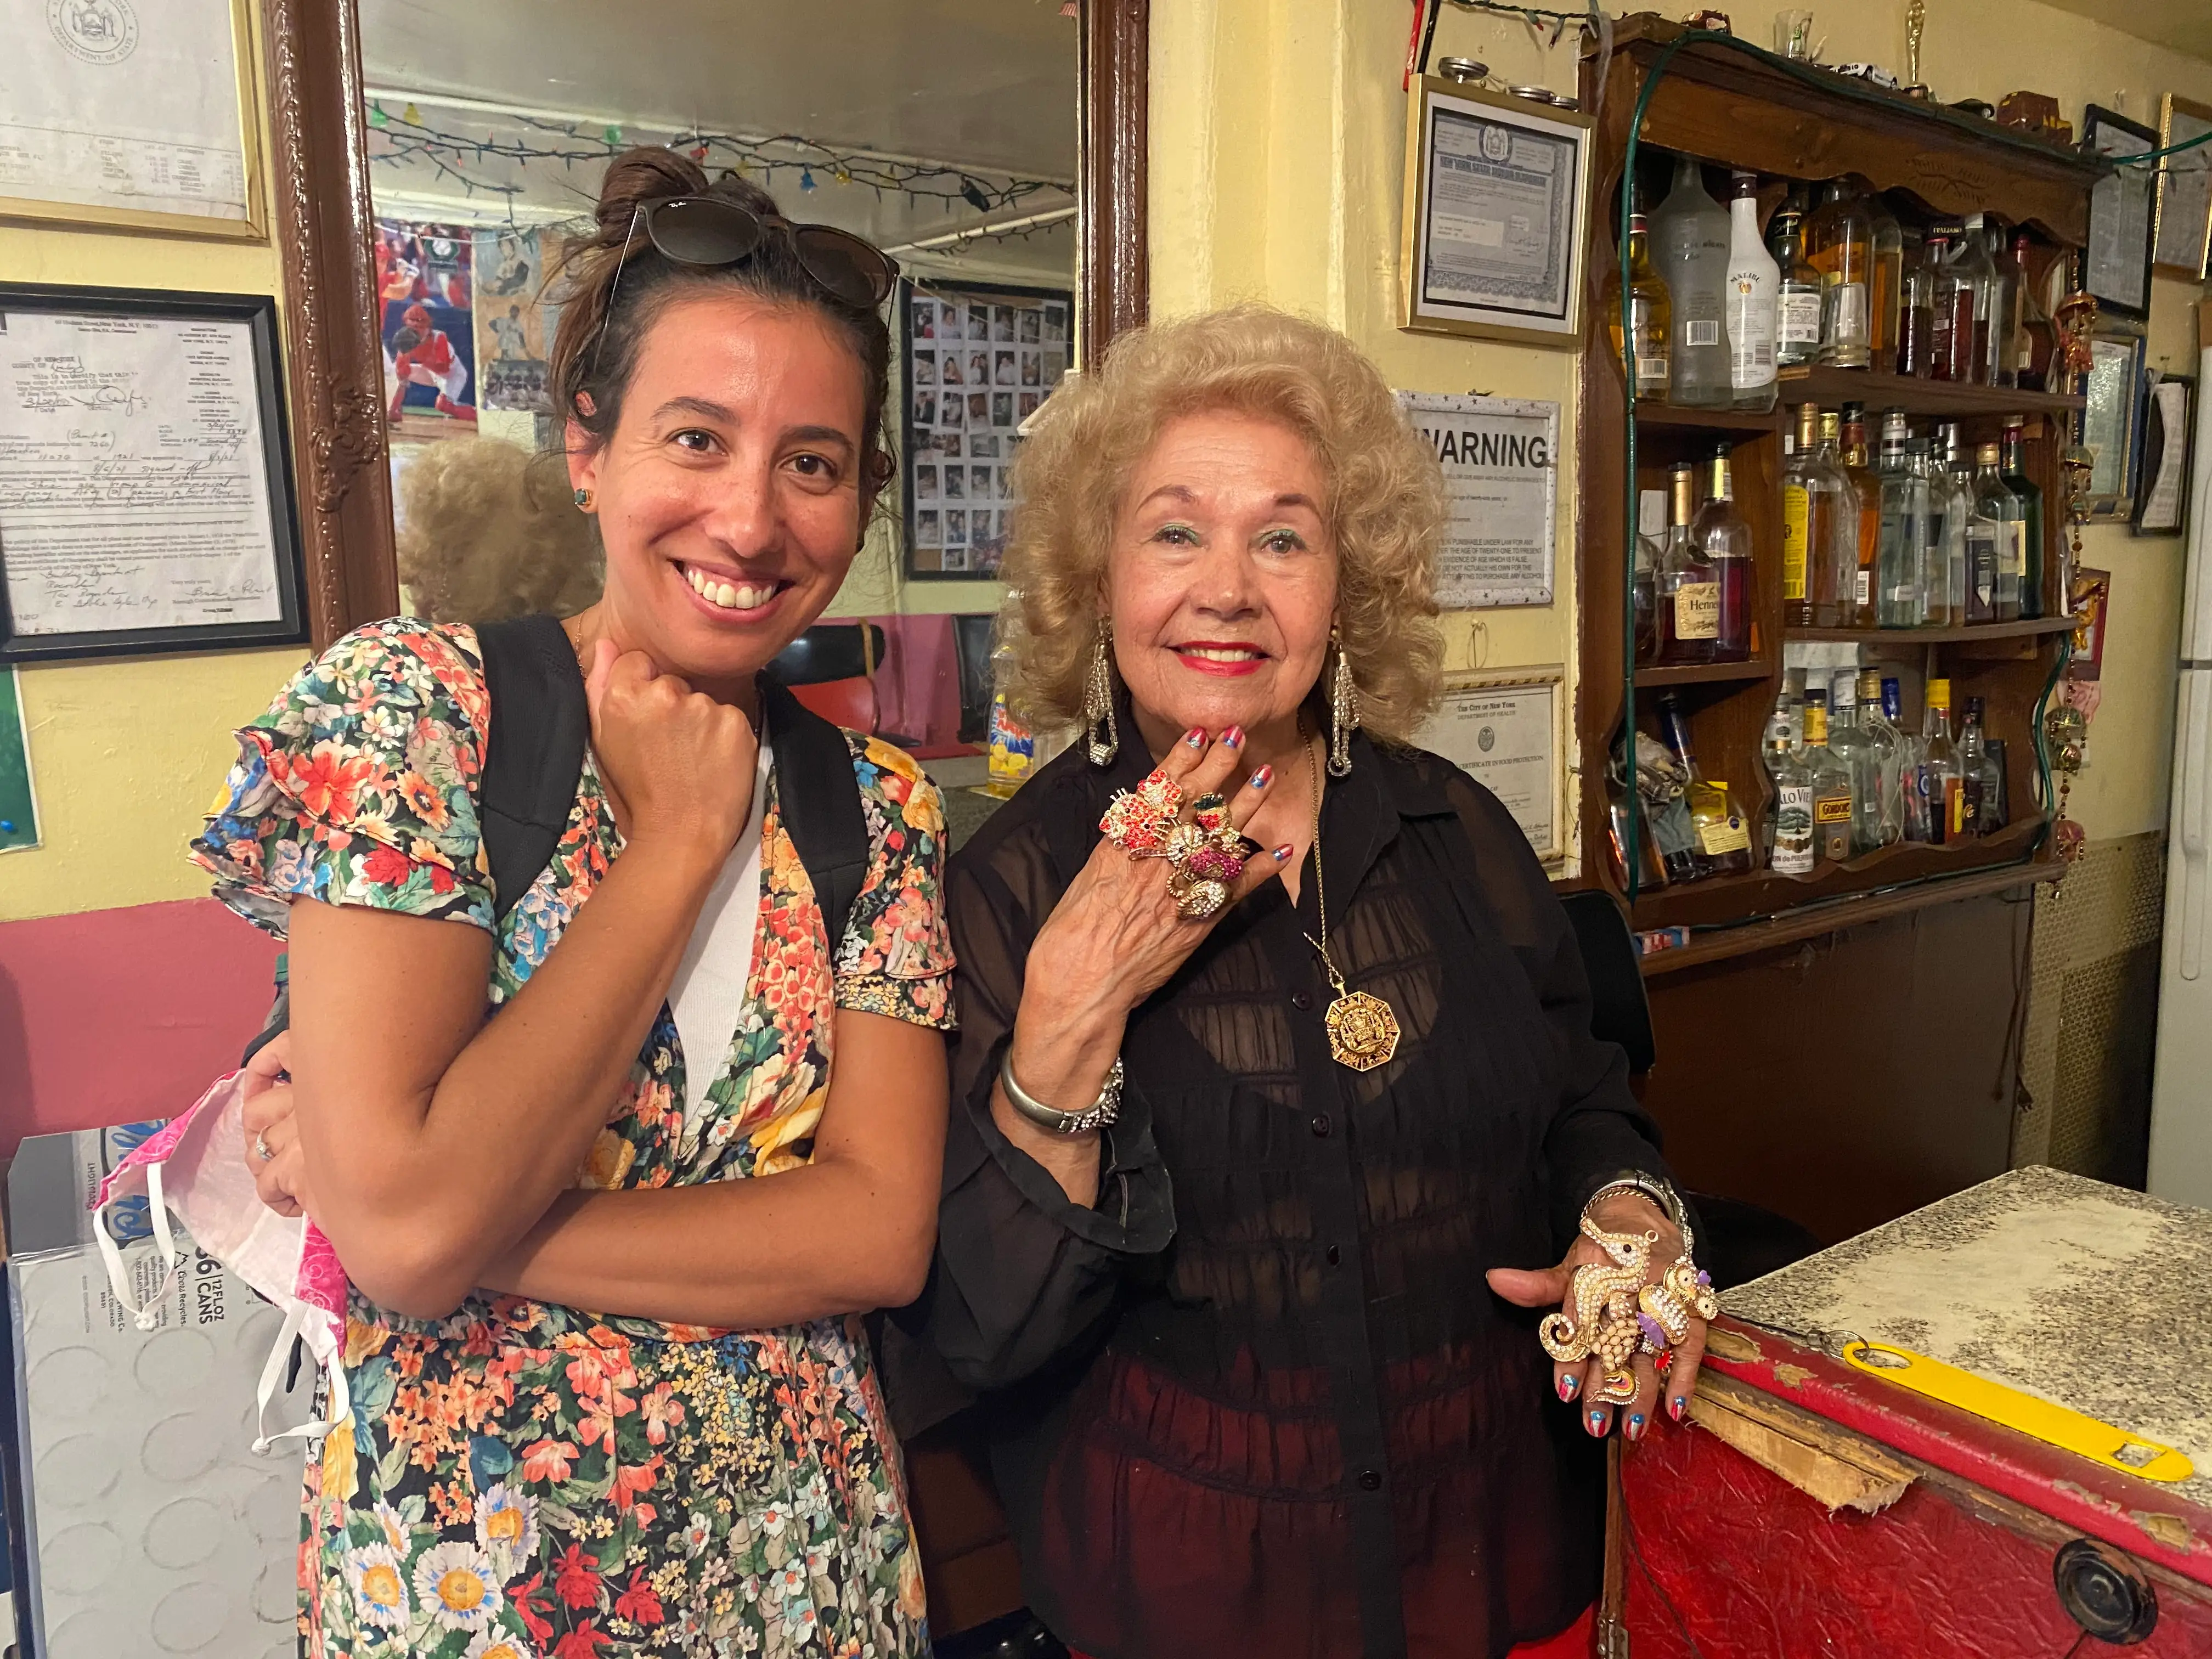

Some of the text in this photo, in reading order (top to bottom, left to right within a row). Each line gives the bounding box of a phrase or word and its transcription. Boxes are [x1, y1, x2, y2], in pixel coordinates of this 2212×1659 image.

[1730, 272, 1761, 284] MALIBU
[177, 1270, 188, 1327] Coors Recycles.
[197, 1283, 213, 1324] CANS
